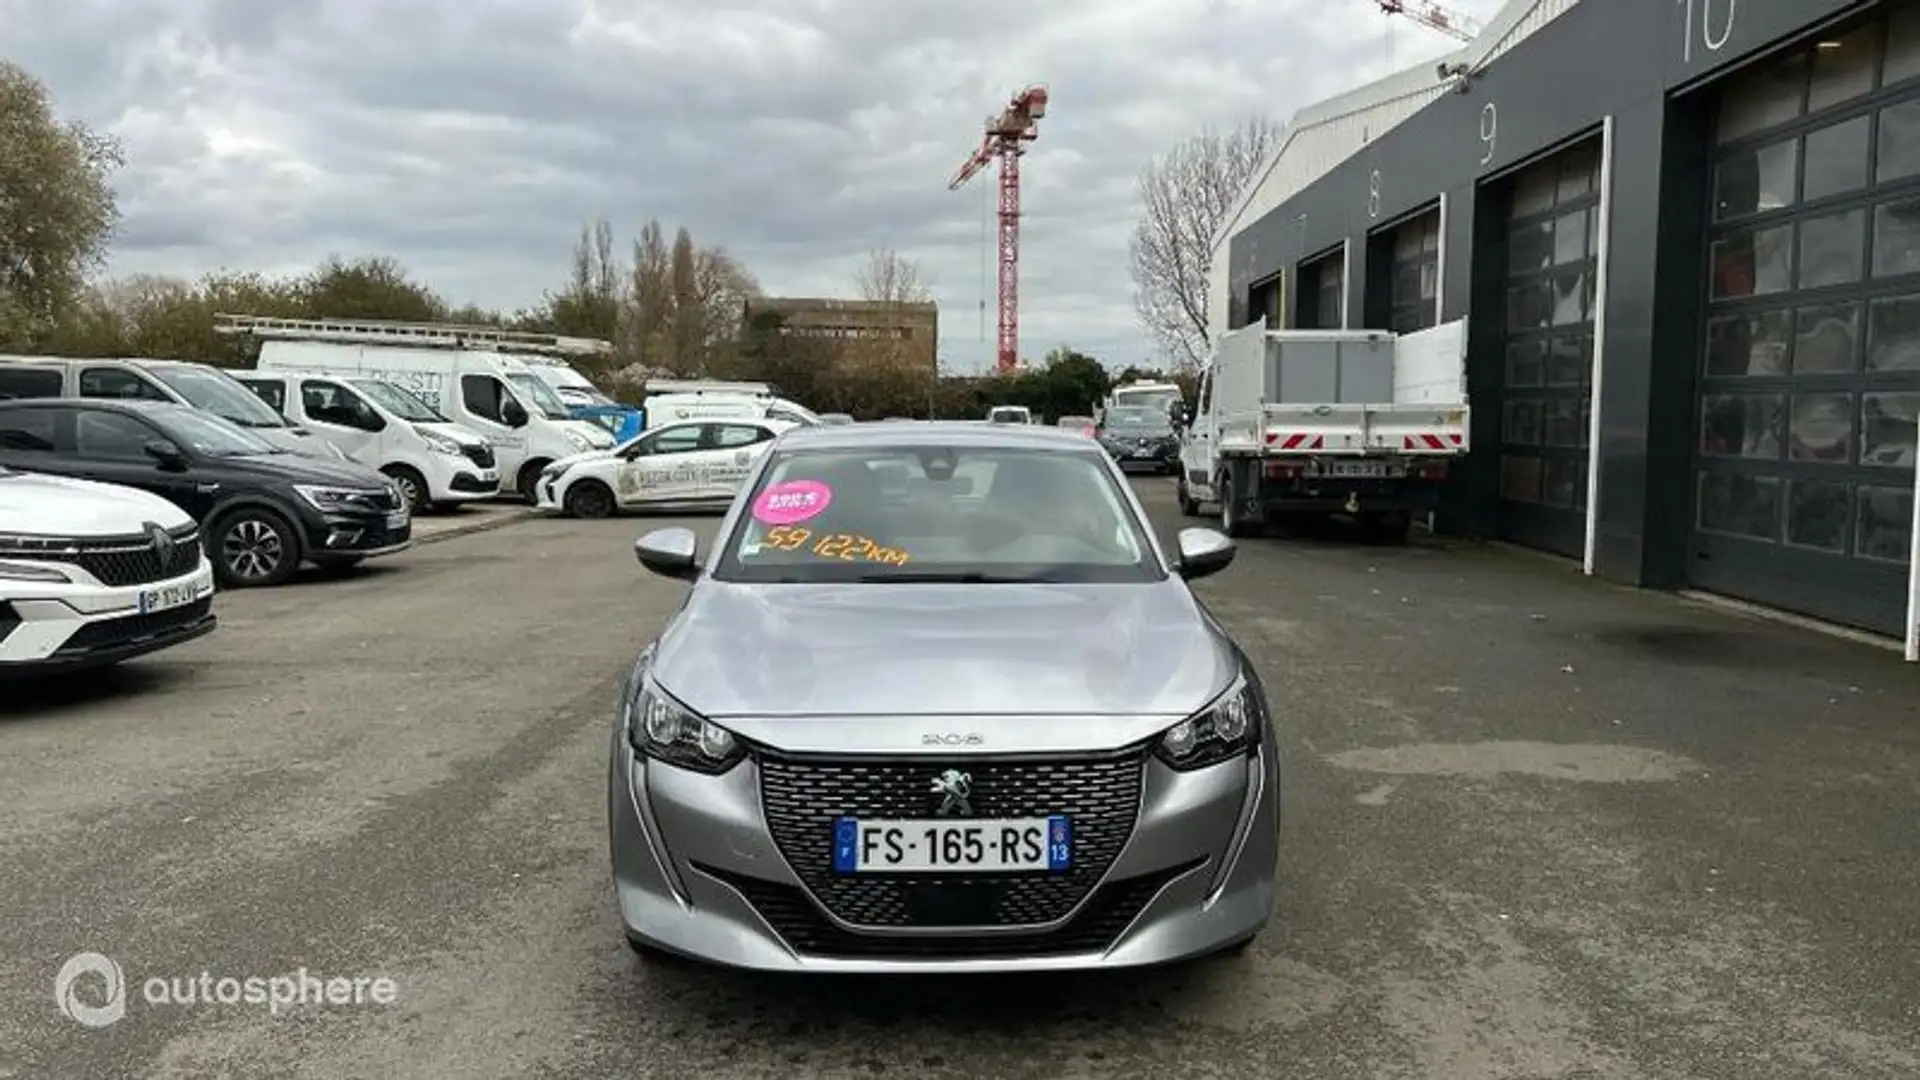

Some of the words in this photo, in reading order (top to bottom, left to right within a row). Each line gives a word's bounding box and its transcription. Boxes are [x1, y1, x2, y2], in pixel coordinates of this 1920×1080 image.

[1678, 0, 1735, 63] 10
[1479, 102, 1497, 166] 9
[1367, 169, 1381, 218] 8
[764, 525, 812, 551] 59
[921, 732, 985, 746] 208
[862, 827, 1042, 865] FS-165-RS
[1050, 844, 1069, 862] 13
